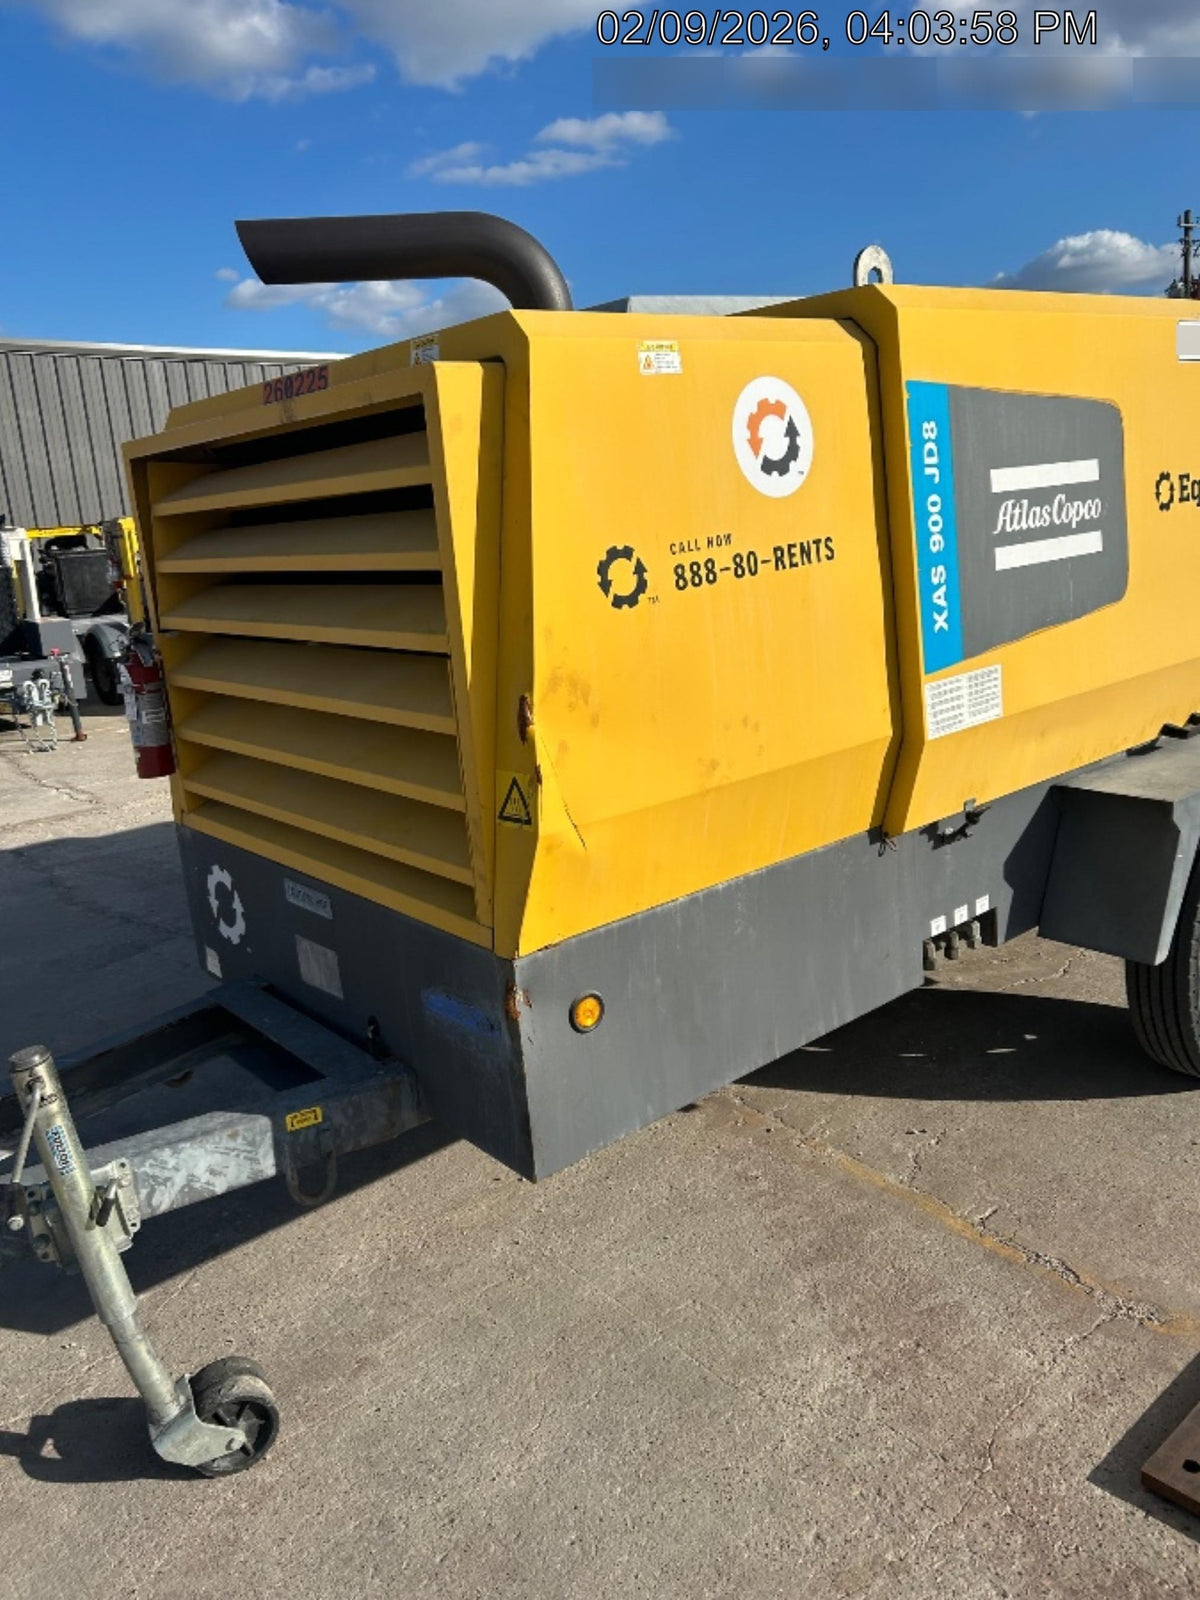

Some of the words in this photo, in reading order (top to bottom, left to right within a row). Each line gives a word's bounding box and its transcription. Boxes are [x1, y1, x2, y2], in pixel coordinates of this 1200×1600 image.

[264, 366, 329, 404] 260225
[922, 420, 939, 483] JD8
[927, 494, 944, 552] 900
[992, 499, 1051, 535] Atlas
[1052, 493, 1102, 529] Copco
[669, 538, 701, 556] CALL
[706, 533, 732, 549] NOW
[673, 536, 835, 591] 888-80-RENTS
[931, 565, 948, 633] XAS
